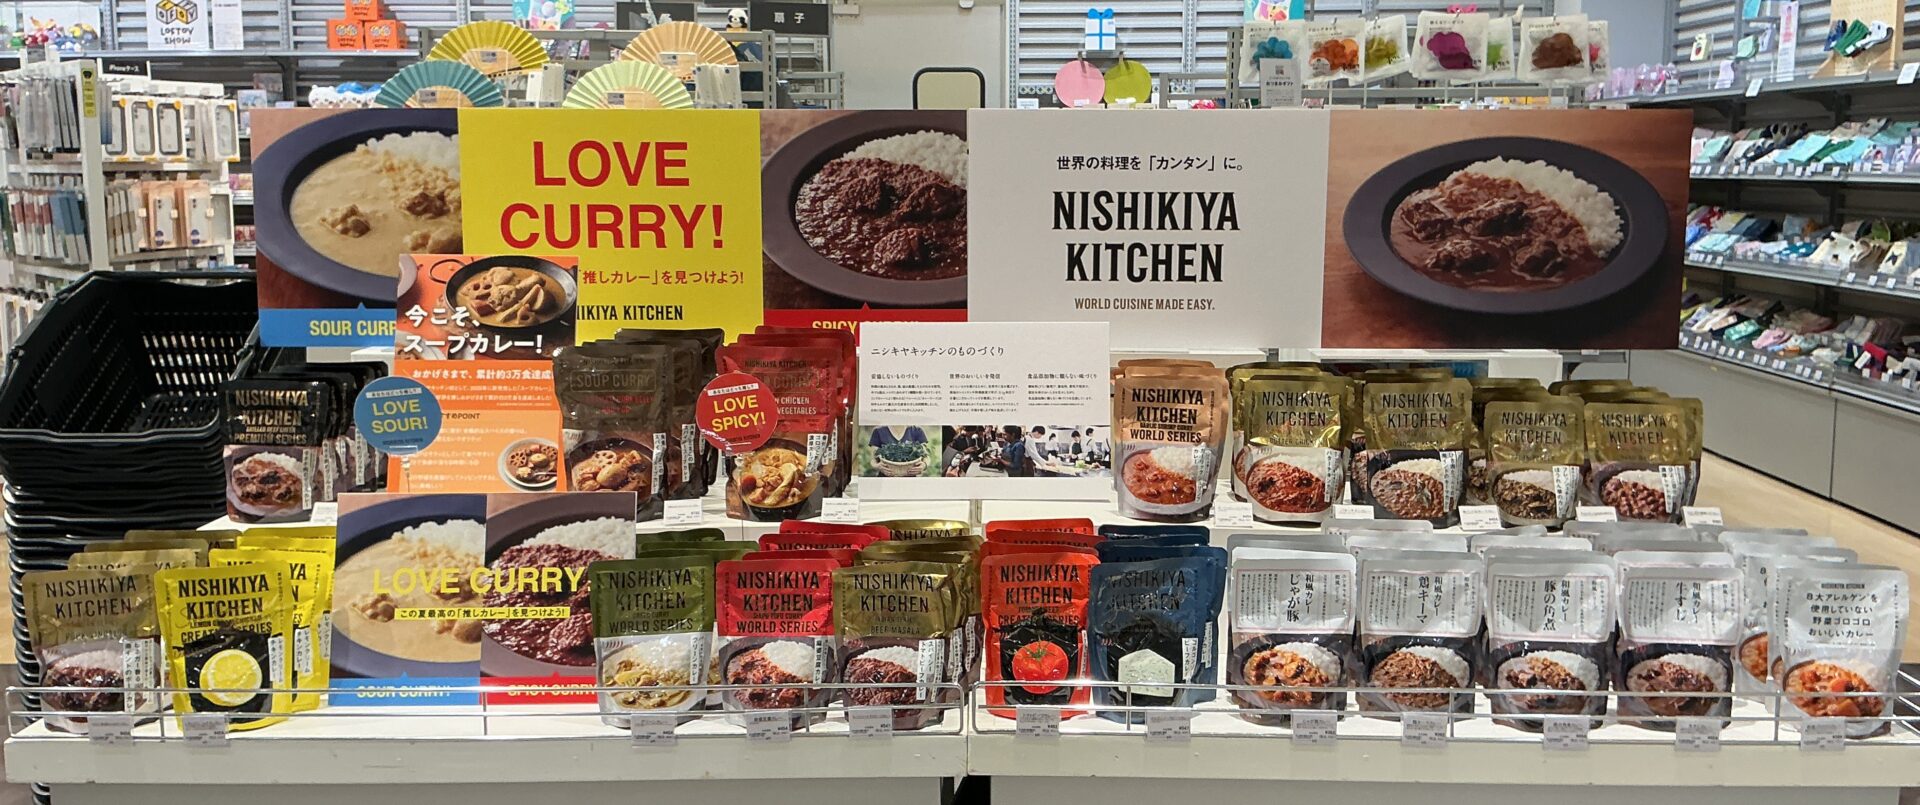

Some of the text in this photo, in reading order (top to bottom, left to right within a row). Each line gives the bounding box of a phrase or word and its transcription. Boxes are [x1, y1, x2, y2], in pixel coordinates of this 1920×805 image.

[533, 141, 689, 187] LOVE
[1056, 155, 1243, 171] 世界の料理を「カンタン」に。
[1052, 190, 1241, 231] NISHIKIYA
[500, 202, 725, 250] CURRY!
[1065, 242, 1224, 283] KITCHEN
[578, 269, 744, 286] 推しカレー」を見つけよう!
[623, 305, 684, 321] KITCHEN
[1075, 298, 1216, 310] WORLD CUISINE MADE EASY.
[404, 304, 481, 328] 今こそ、
[309, 320, 396, 336] SOUR CURR
[403, 333, 543, 354] スープカレー!
[870, 345, 1005, 357] ニシキヤキッチンのものづくり
[576, 374, 651, 388] SOUP CURRY
[235, 389, 309, 407] NISHIKIYA
[713, 394, 759, 414] LOVE
[781, 397, 810, 405] CHICKEN
[1131, 388, 1204, 405] NISHIKIYA
[1262, 391, 1331, 407] NISHIKIYA
[1382, 392, 1453, 409] NISHIKIYA
[372, 399, 421, 416] LOVE
[776, 406, 817, 415] VEGETABLES
[1136, 407, 1198, 425] KITCHEN
[241, 409, 303, 426] KITCHEN
[371, 416, 428, 434] SOUR!
[711, 411, 766, 432] SPICY!
[1266, 411, 1326, 427] KITCHEN
[1387, 413, 1447, 428] KITCHEN
[1501, 411, 1568, 427] NISHIKIYA
[1601, 413, 1667, 428] NISHIKIYA
[234, 433, 307, 445] PREMIUM SERIES
[1130, 429, 1202, 443] WORLD SERIES
[1505, 429, 1562, 444] KITCHEN
[1609, 431, 1664, 445] KITCHEN
[371, 566, 461, 596] LOVE
[608, 568, 692, 590] NISHIKIYA
[736, 571, 820, 590] NISHIKIYA
[853, 573, 934, 593] NISHIKIYA
[1000, 564, 1079, 584] NISHIKIYA
[45, 574, 137, 599] NISHIKIYA
[177, 574, 270, 598] NISHIKIYA
[1005, 586, 1073, 604] KITCHEN
[1305, 573, 1314, 614] 和風カレー
[616, 591, 686, 611] KITCHEN
[743, 593, 814, 612] KITCHEN
[861, 595, 929, 613] KITCHEN
[1286, 573, 1301, 622] じゃが豚
[1416, 576, 1430, 624] 鶏キーマ
[1434, 576, 1443, 617] 和風カレー
[1543, 579, 1556, 631] 豚の角煮
[1561, 579, 1570, 622] 和風カレー
[55, 597, 133, 619] KITCHEN
[186, 597, 263, 621] KITCHEN
[400, 608, 565, 618] この夏最高の「推しカレー」を見つけよう!
[1810, 604, 1873, 614] 使用していない
[609, 617, 693, 634] WORLD SERIES
[736, 620, 818, 634] WORLD SERIES
[1812, 616, 1871, 627] 野菜ゴロゴロ
[1808, 628, 1874, 638] おいしいカレー
